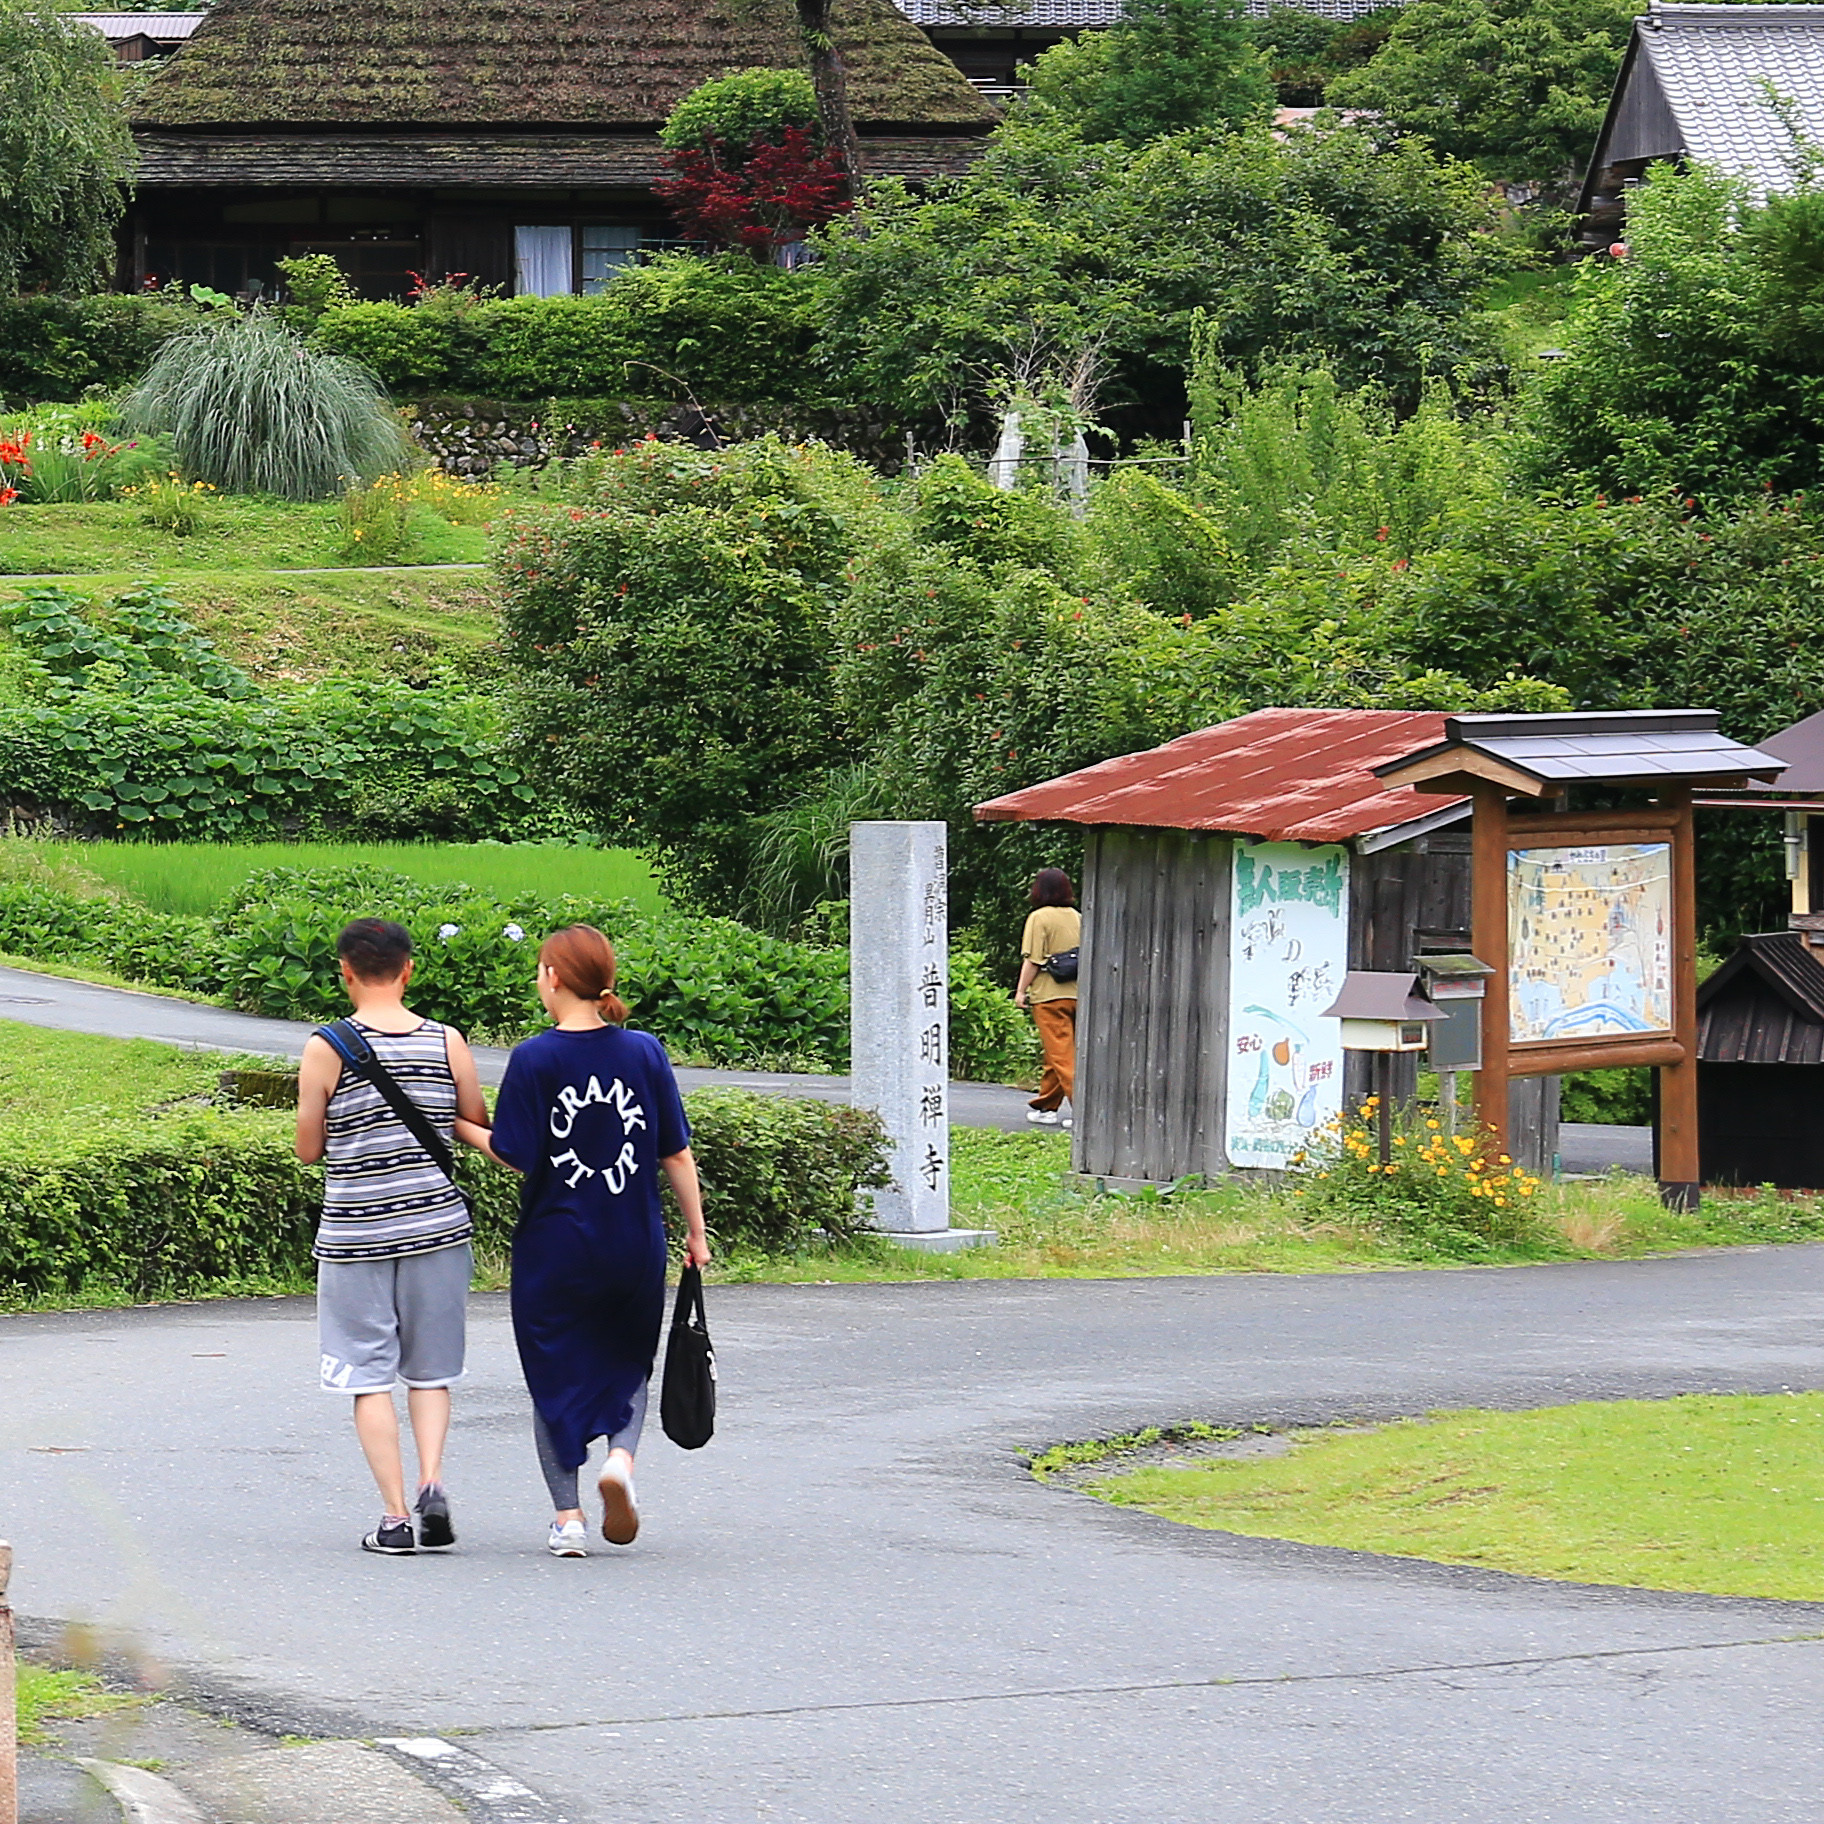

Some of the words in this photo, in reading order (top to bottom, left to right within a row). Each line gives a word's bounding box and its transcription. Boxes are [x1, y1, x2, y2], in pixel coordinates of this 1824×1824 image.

[1236, 1033, 1263, 1055] 安心
[917, 962, 944, 1192] 普明禅寺
[1308, 1060, 1334, 1082] 新鮮
[550, 1075, 646, 1139] CRANK
[550, 1147, 595, 1189] IT
[601, 1141, 639, 1194] UP
